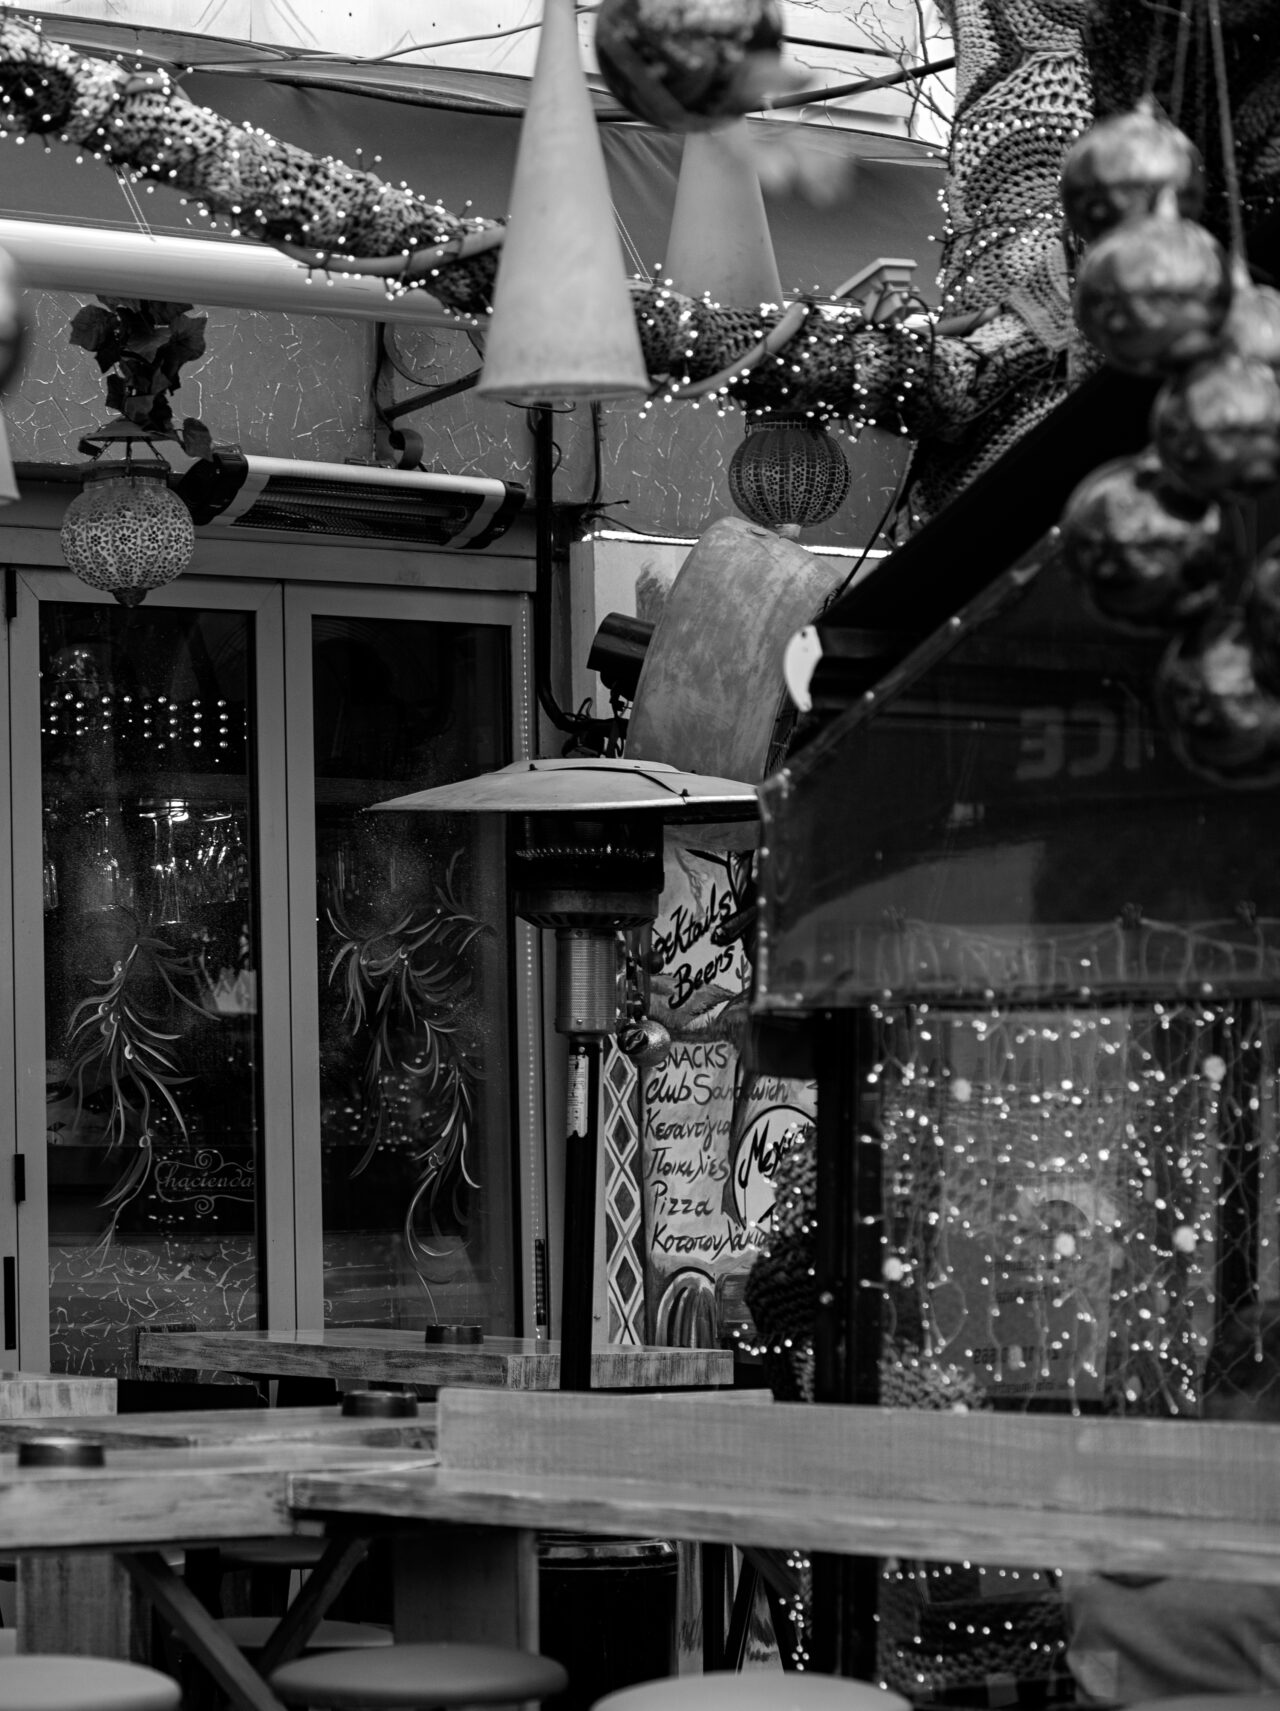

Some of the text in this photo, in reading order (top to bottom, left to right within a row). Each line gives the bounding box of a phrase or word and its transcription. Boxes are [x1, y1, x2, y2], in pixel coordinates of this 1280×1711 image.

[652, 883, 734, 965] ocKtails
[669, 945, 735, 1009] Beers
[650, 1179, 714, 1217] Pizza
